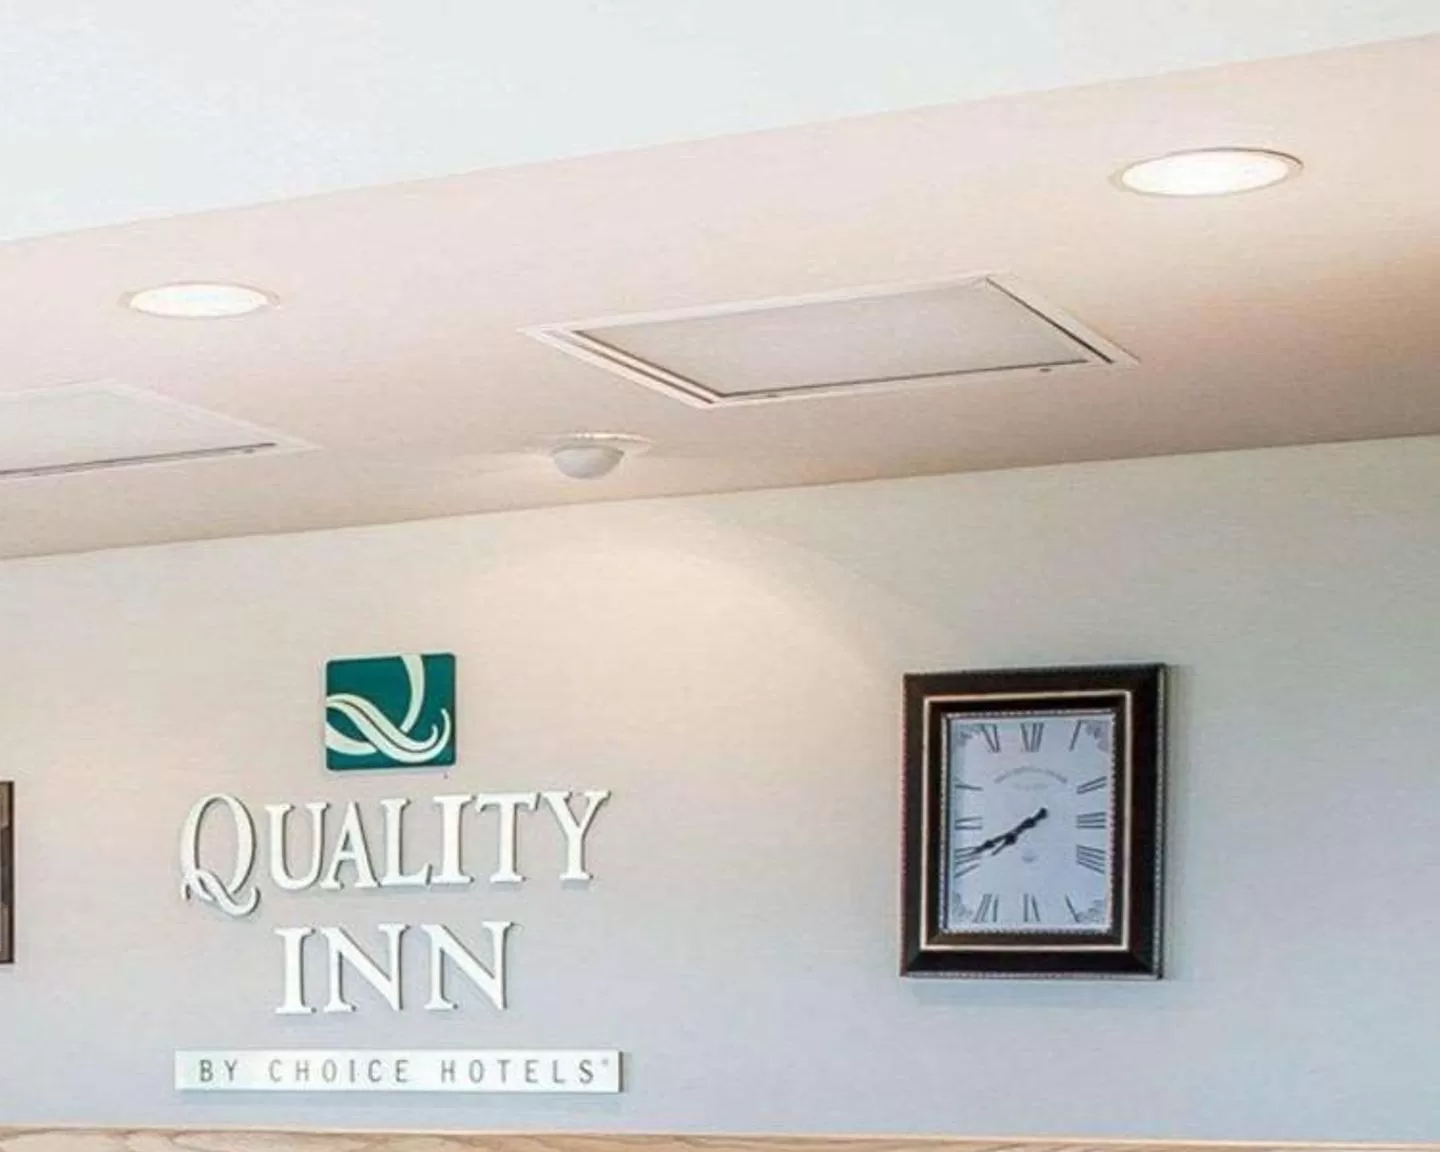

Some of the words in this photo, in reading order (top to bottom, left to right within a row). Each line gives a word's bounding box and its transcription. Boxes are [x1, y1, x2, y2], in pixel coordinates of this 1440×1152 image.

[180, 790, 611, 917] QUALITY
[273, 921, 516, 1016] INN
[199, 1059, 238, 1083] BY
[268, 1059, 410, 1083] CHOICE
